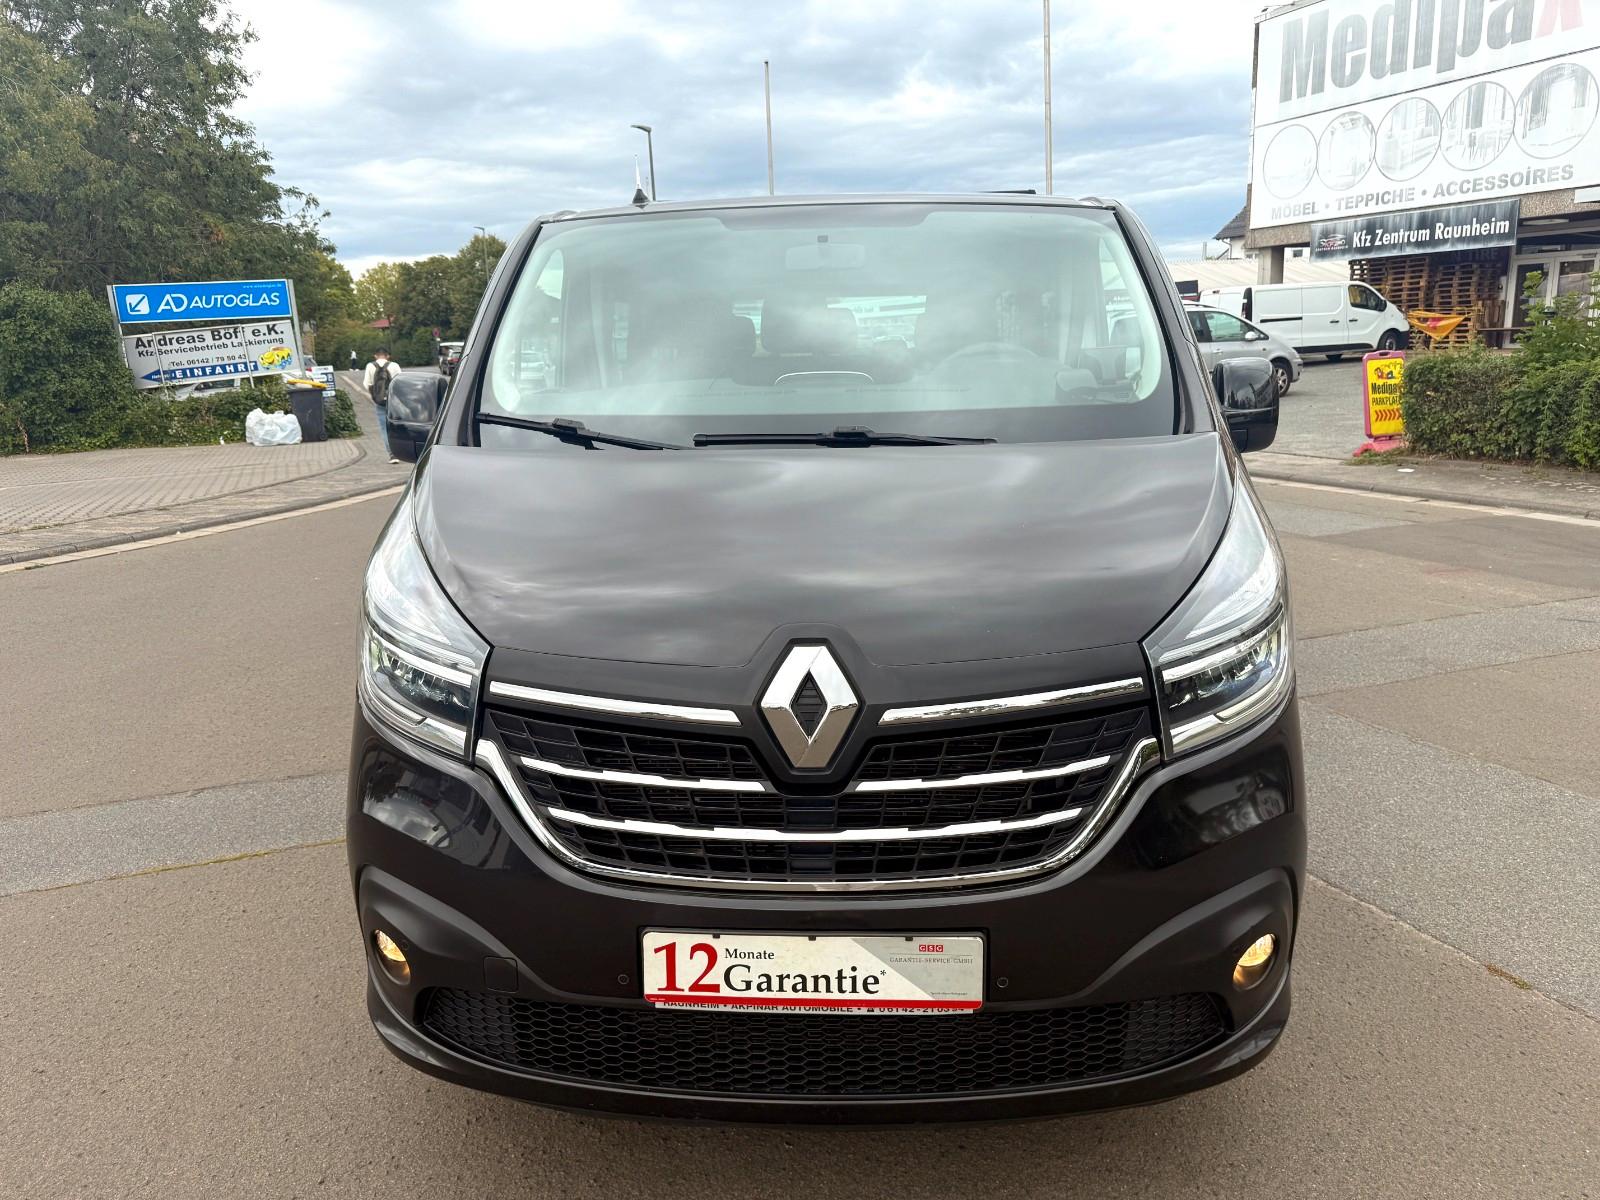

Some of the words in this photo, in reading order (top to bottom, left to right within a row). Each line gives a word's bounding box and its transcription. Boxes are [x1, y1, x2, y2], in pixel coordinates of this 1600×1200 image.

[1336, 187, 1416, 211] TEPPICHE
[1353, 230, 1372, 248] Kfz
[1374, 227, 1431, 246] Zentrum
[1434, 217, 1510, 240] Raunheim
[157, 293, 189, 313] AD
[190, 292, 280, 308] AUTOGLAS
[135, 332, 206, 349] Andreas
[251, 323, 284, 337] e.K.
[175, 362, 256, 378] EINFAHRT
[187, 357, 209, 366] 06142
[653, 941, 720, 994] 12
[725, 948, 775, 960] Monate
